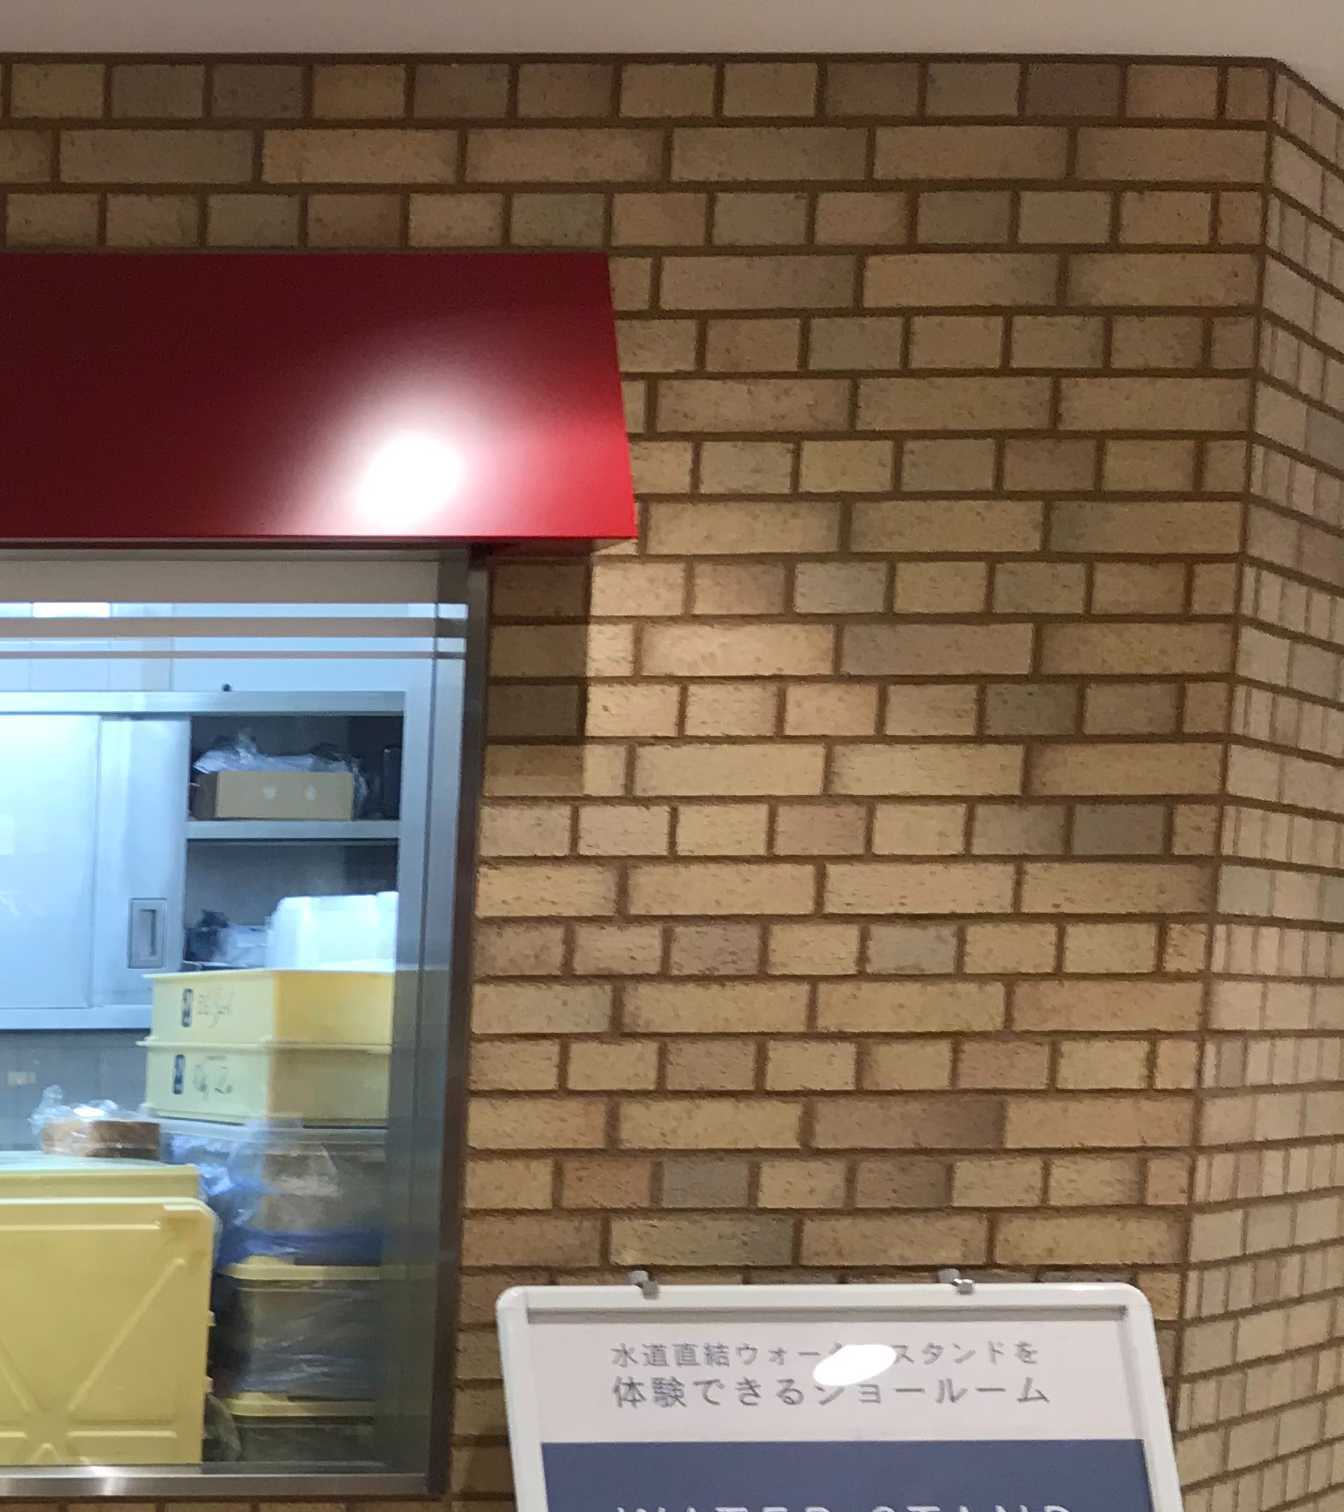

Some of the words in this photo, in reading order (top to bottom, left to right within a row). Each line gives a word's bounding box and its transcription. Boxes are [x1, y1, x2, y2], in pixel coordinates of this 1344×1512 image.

[611, 1340, 1040, 1369] 水道直結ウォースタンドを
